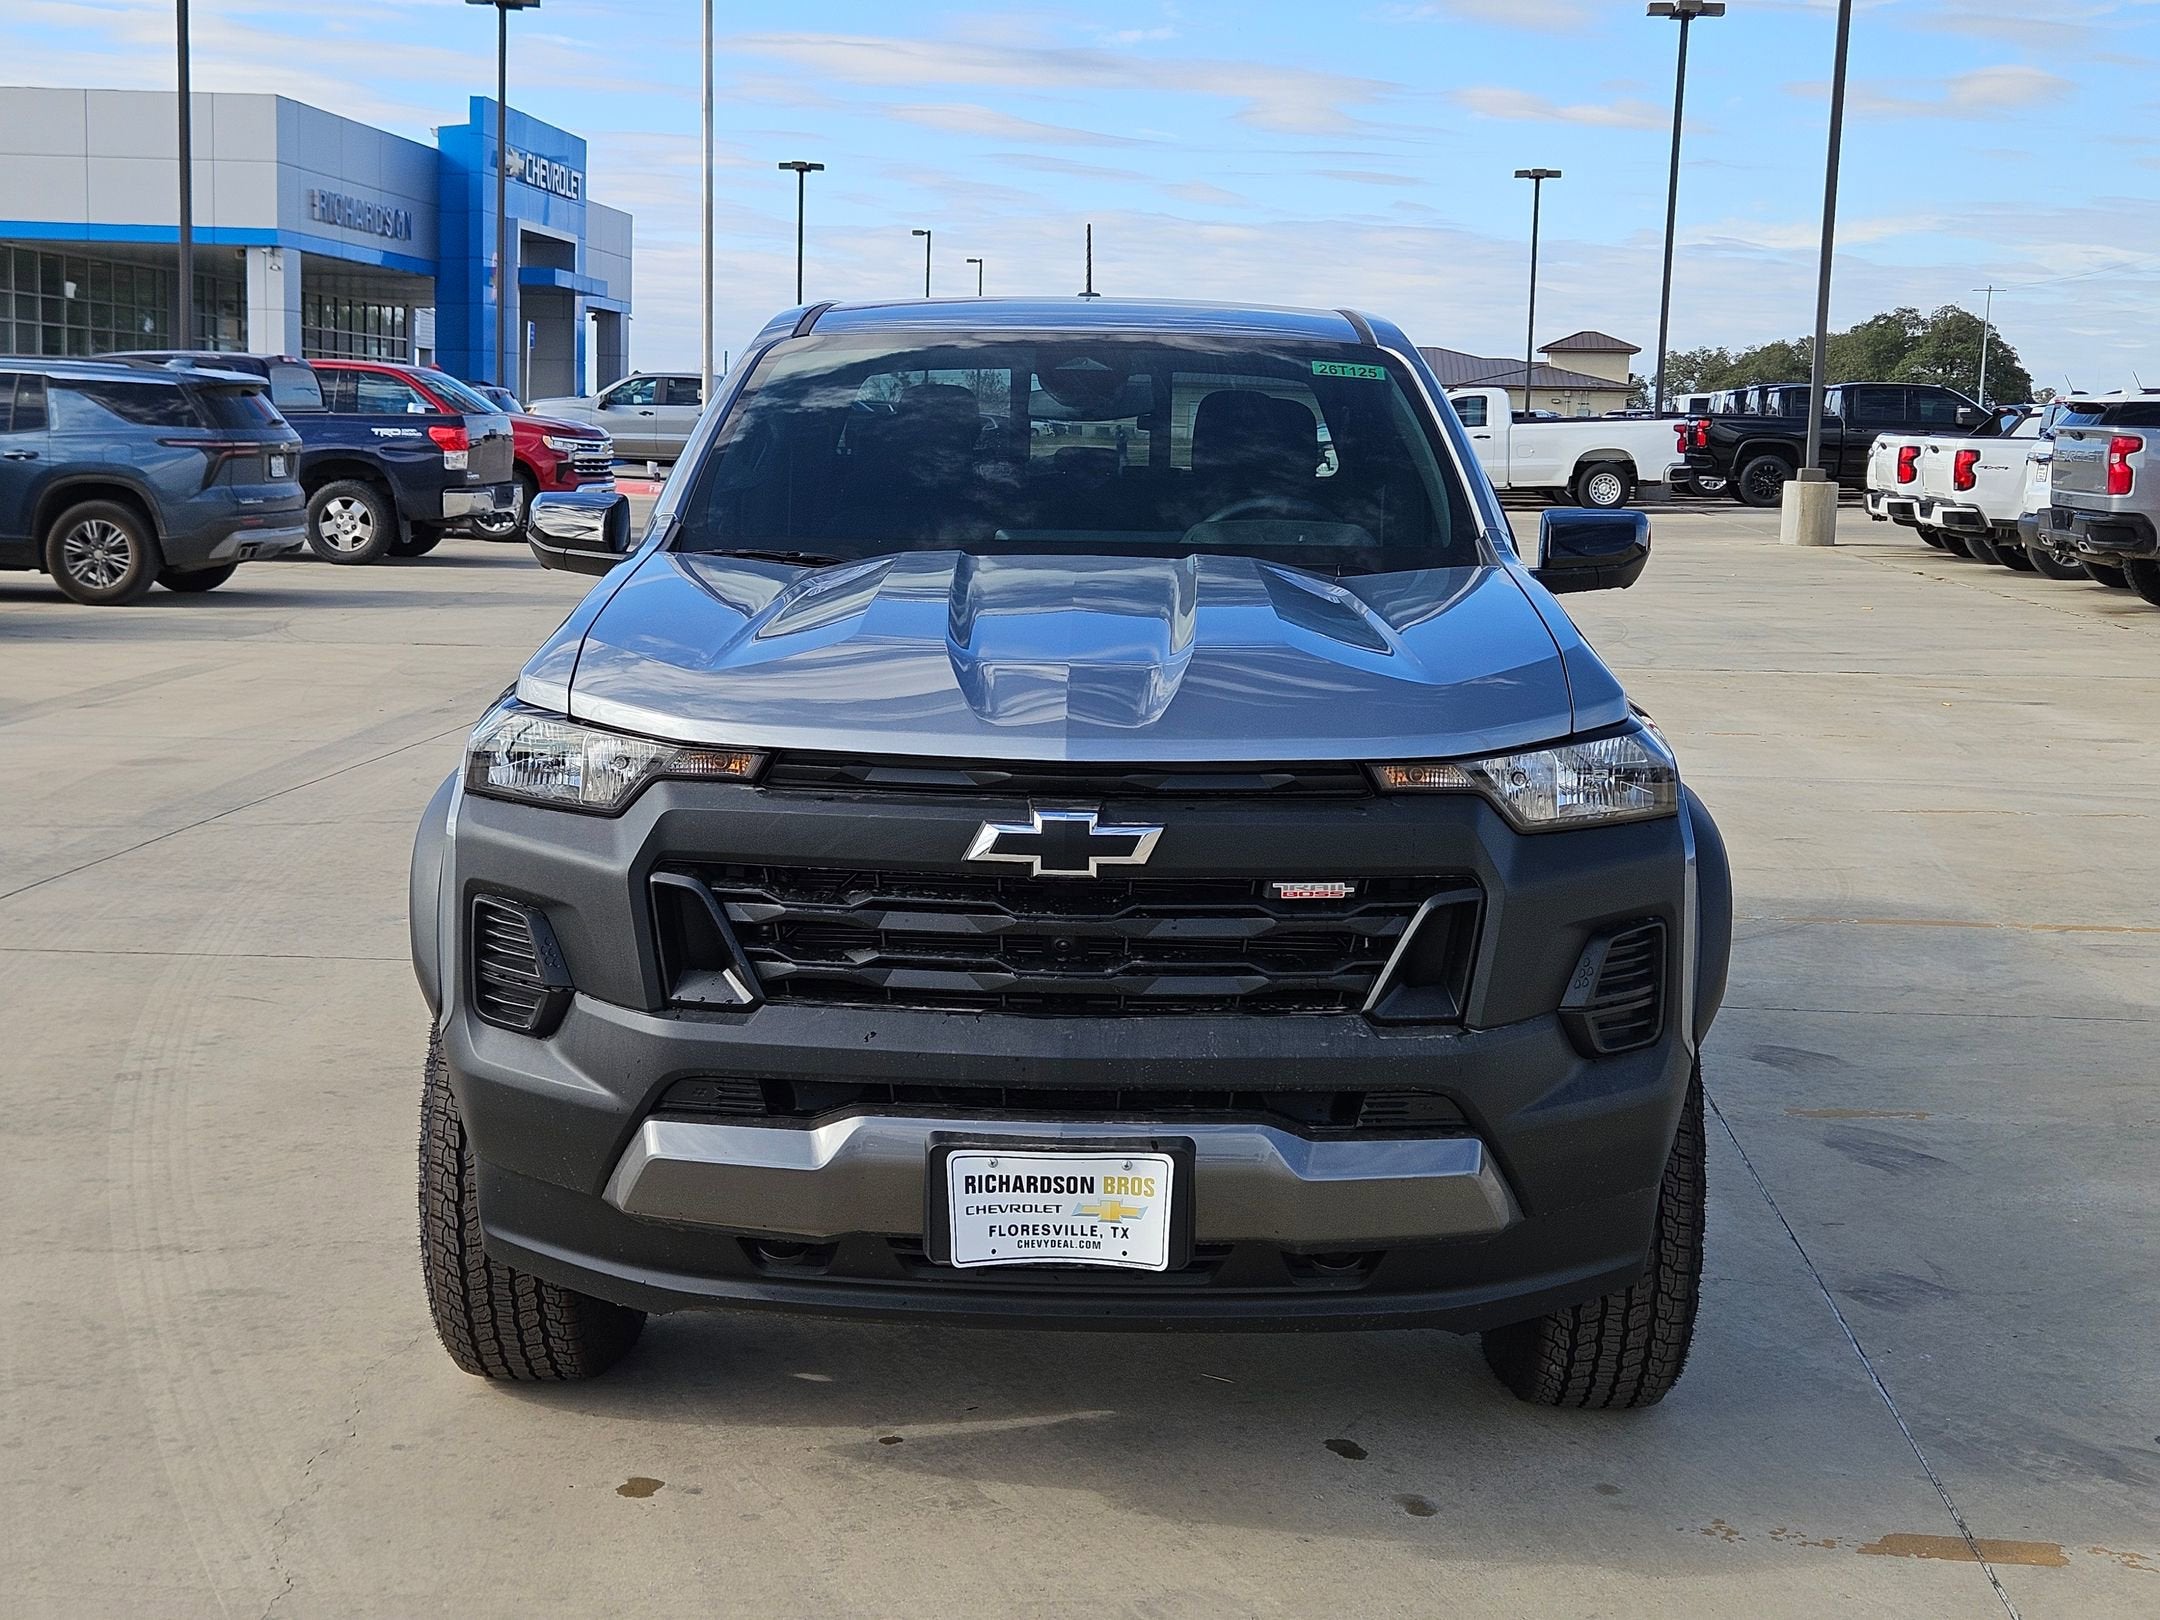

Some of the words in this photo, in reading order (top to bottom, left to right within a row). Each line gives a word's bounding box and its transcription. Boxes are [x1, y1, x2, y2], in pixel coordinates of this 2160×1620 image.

[525, 152, 583, 200] CHEVROLET
[311, 189, 412, 240] RICHARDSON
[1319, 364, 1378, 378] 26T125
[1272, 882, 1355, 892] TRAIL
[1281, 890, 1345, 899] BOSS
[964, 1175, 1095, 1195] RICHARDSON
[1103, 1176, 1155, 1197] BROS
[965, 1204, 1063, 1216] CHEVROLET
[988, 1224, 1104, 1238] FLORESVILLE,
[1110, 1226, 1130, 1240] TX
[1016, 1239, 1102, 1250] CHEVYDEAL.COM
